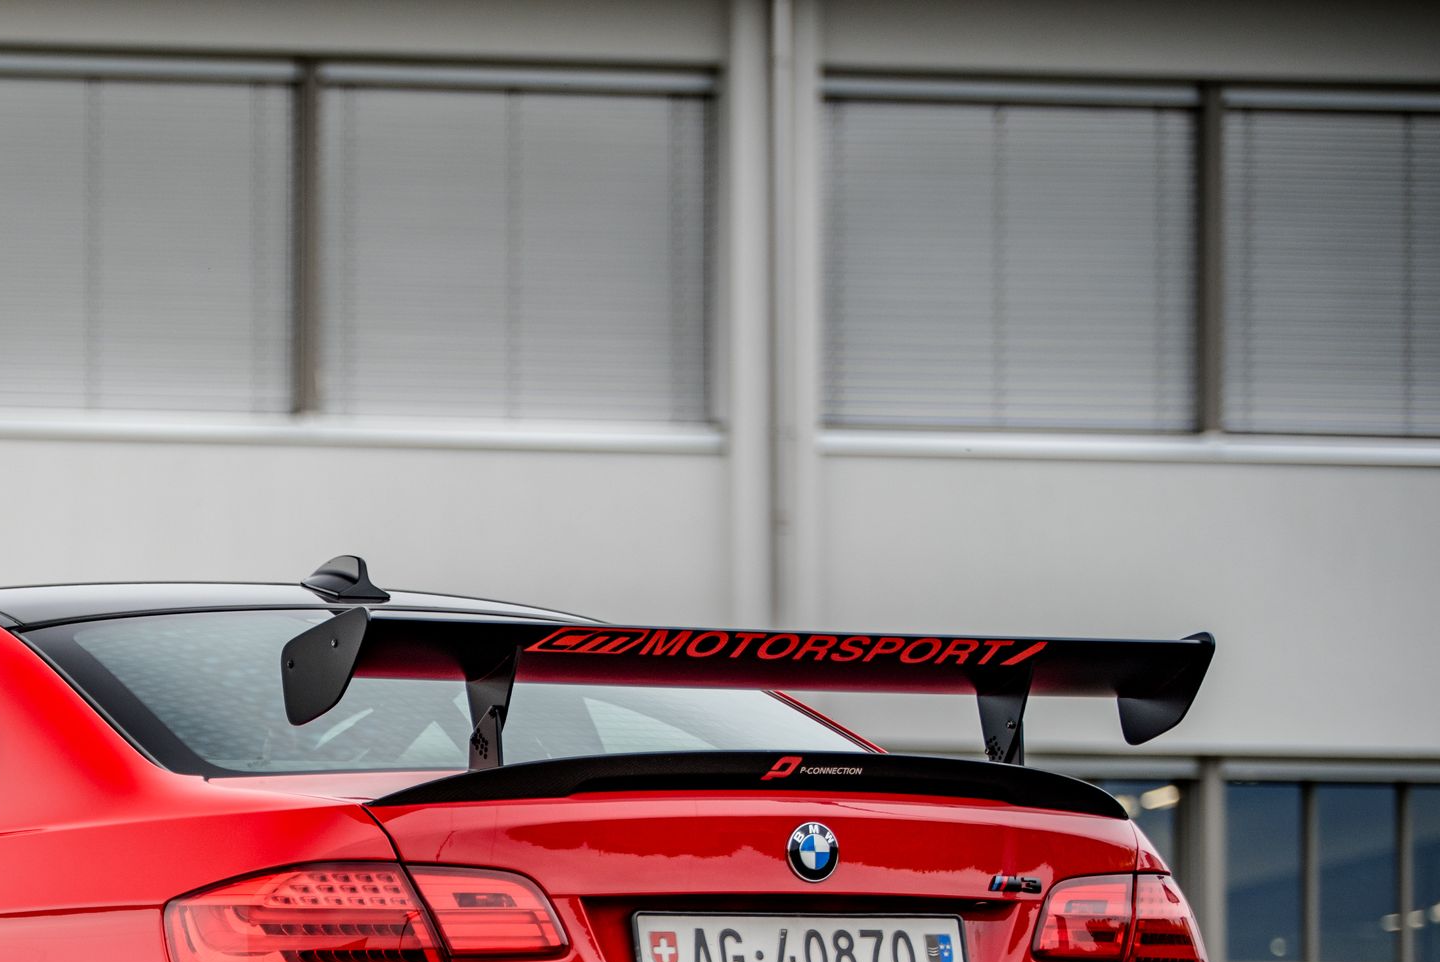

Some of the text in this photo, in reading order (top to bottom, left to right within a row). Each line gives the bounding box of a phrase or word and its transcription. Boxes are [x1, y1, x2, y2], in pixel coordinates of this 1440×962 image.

[639, 630, 1015, 666] MOTORSPORT
[800, 766, 863, 775] P-CONNECTION
[793, 824, 835, 844] BMW
